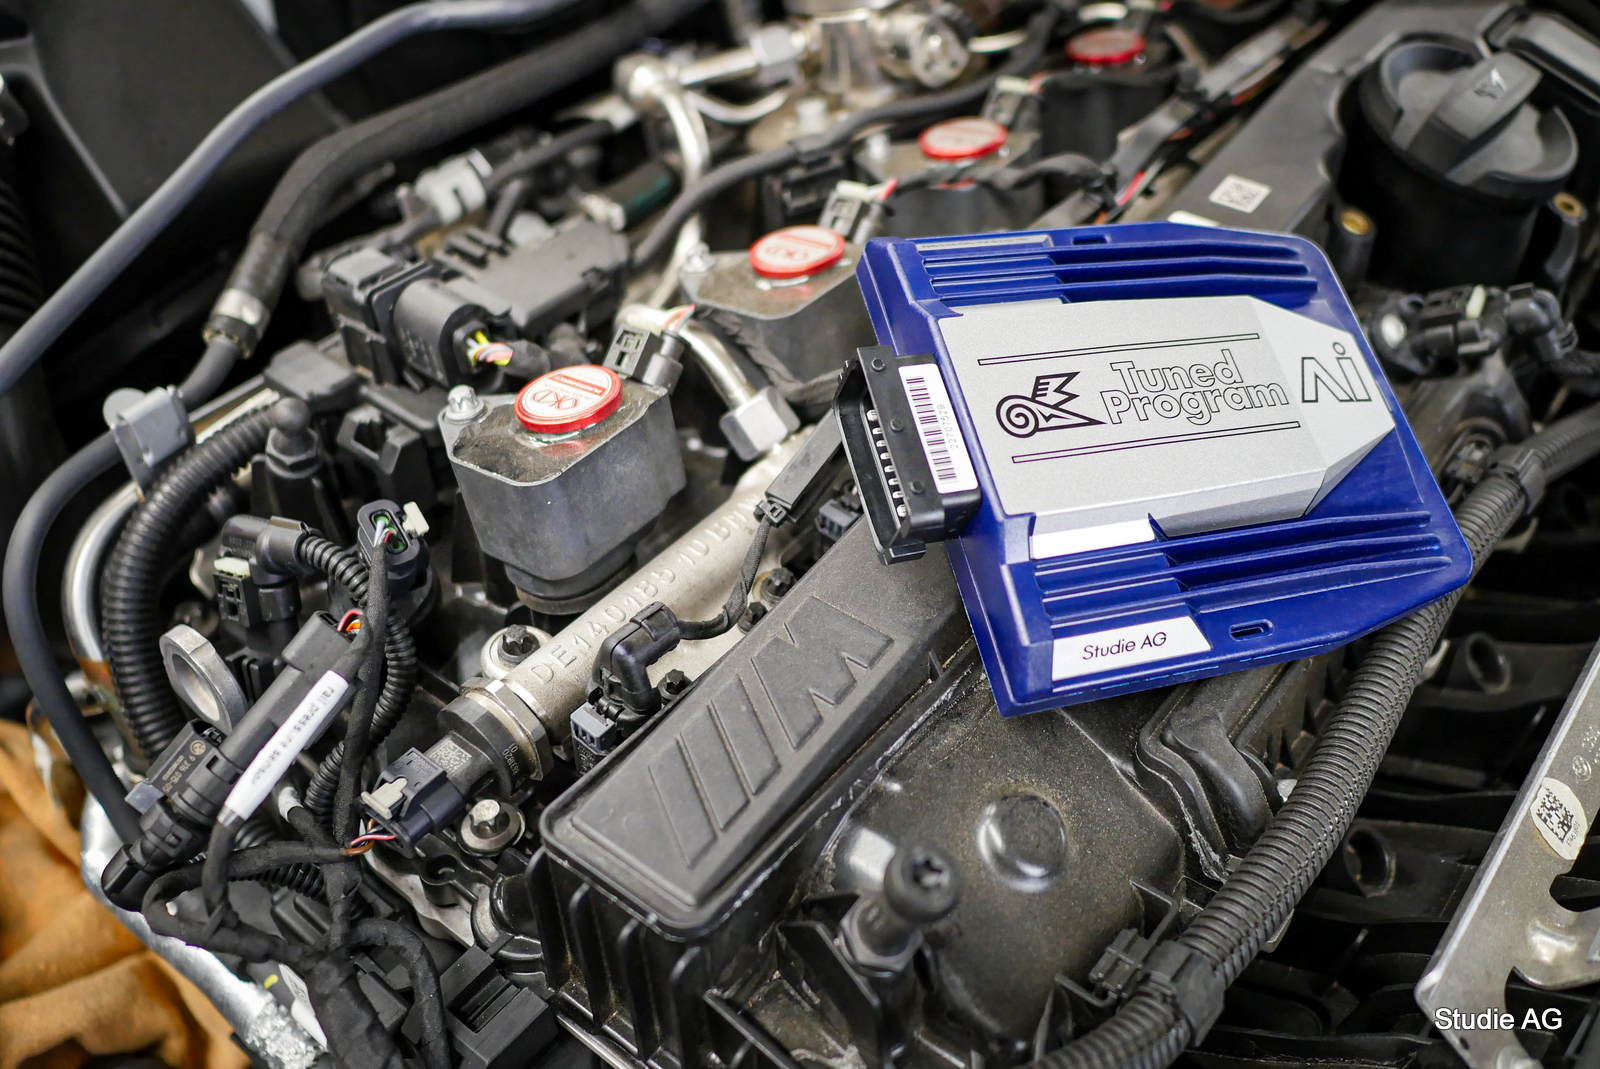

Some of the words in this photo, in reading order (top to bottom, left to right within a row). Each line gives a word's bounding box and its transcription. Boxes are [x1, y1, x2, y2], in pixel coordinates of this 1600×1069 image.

[1110, 349, 1244, 395] Tuned
[1100, 382, 1290, 425] Program
[937, 404, 959, 449] 22707529
[1082, 638, 1136, 660] Studie
[1140, 631, 1167, 649] AG
[318, 686, 335, 706] rail
[280, 703, 319, 748] pressure
[251, 750, 281, 785] sensor
